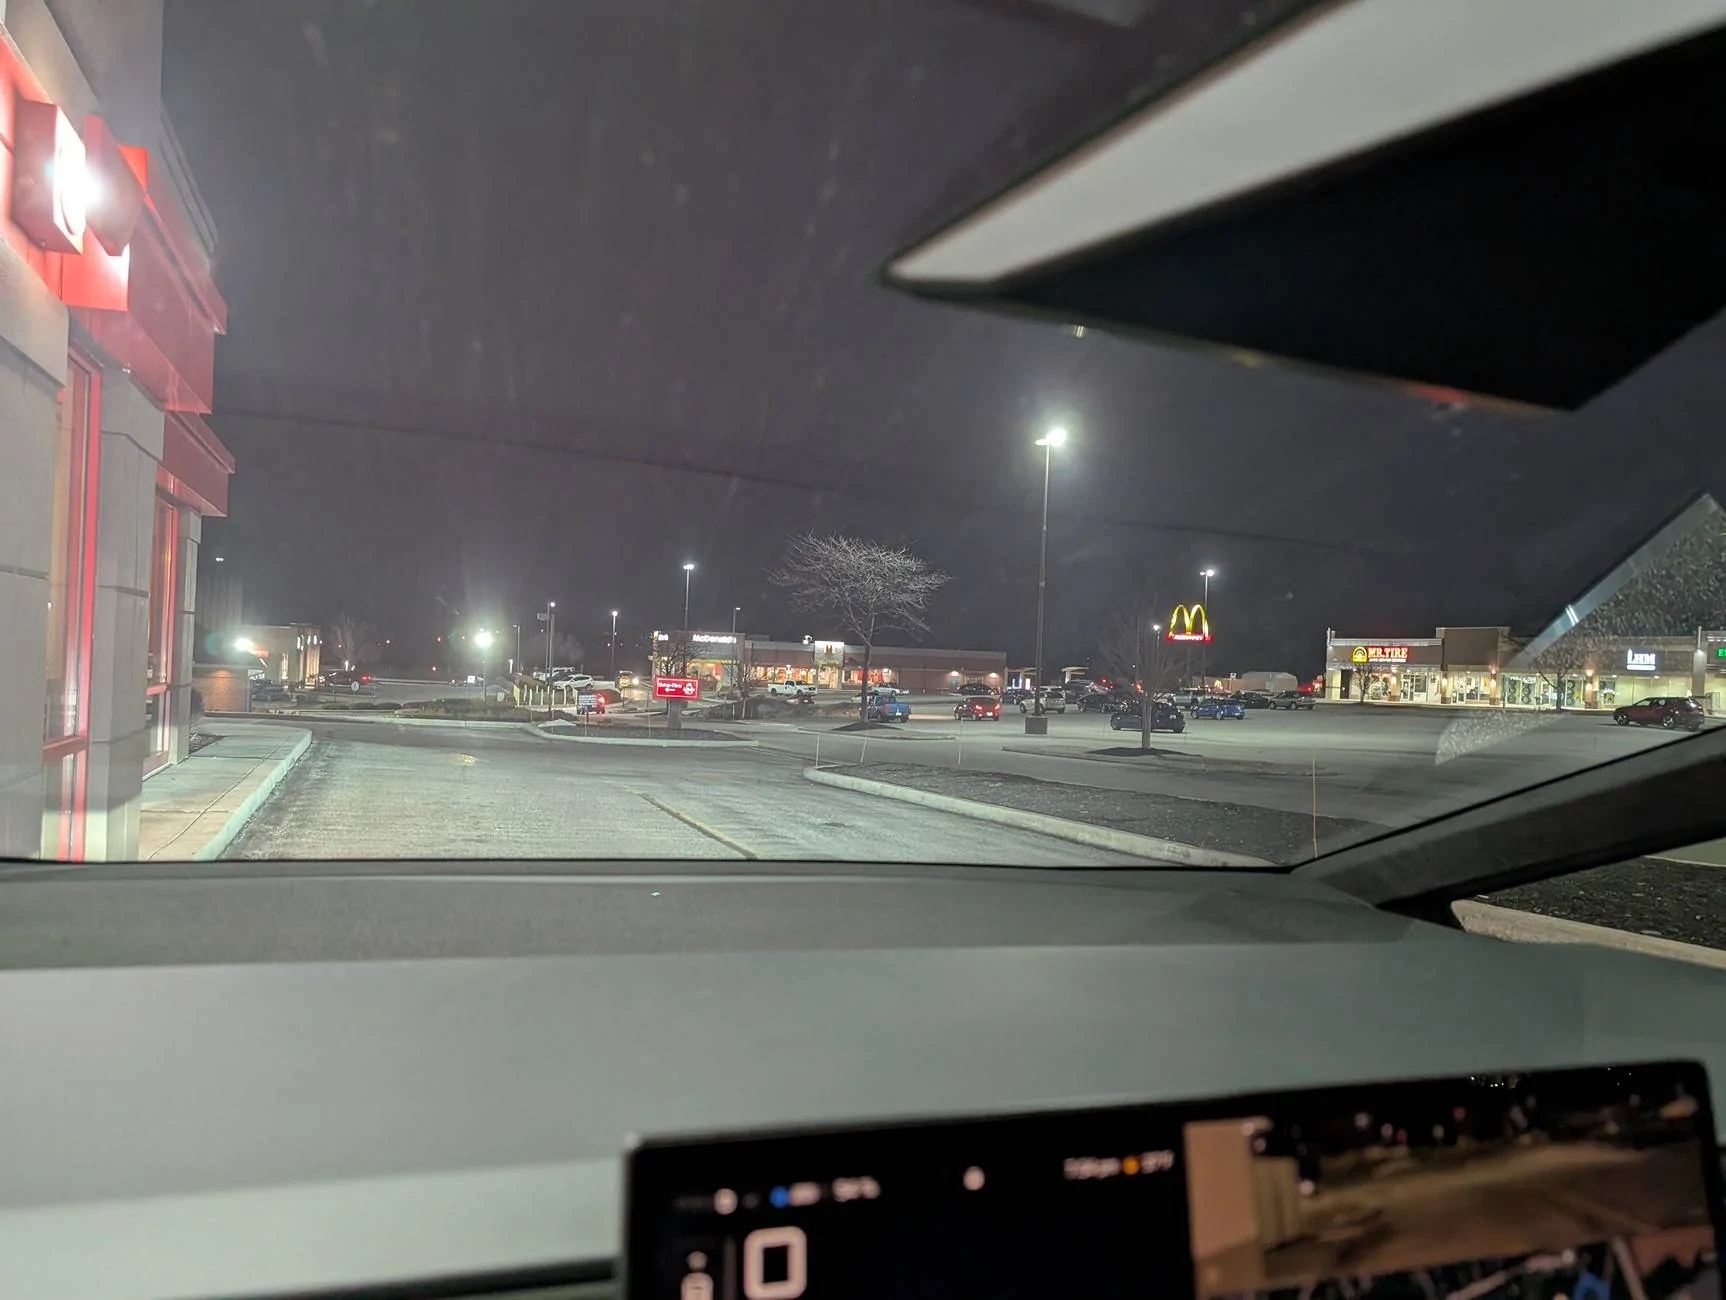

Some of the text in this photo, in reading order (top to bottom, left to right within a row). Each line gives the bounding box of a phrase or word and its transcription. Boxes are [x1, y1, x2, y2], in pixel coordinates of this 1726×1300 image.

[1384, 647, 1408, 659] TIRE
[1718, 648, 1726, 657] E
[743, 1225, 807, 1300] 0
